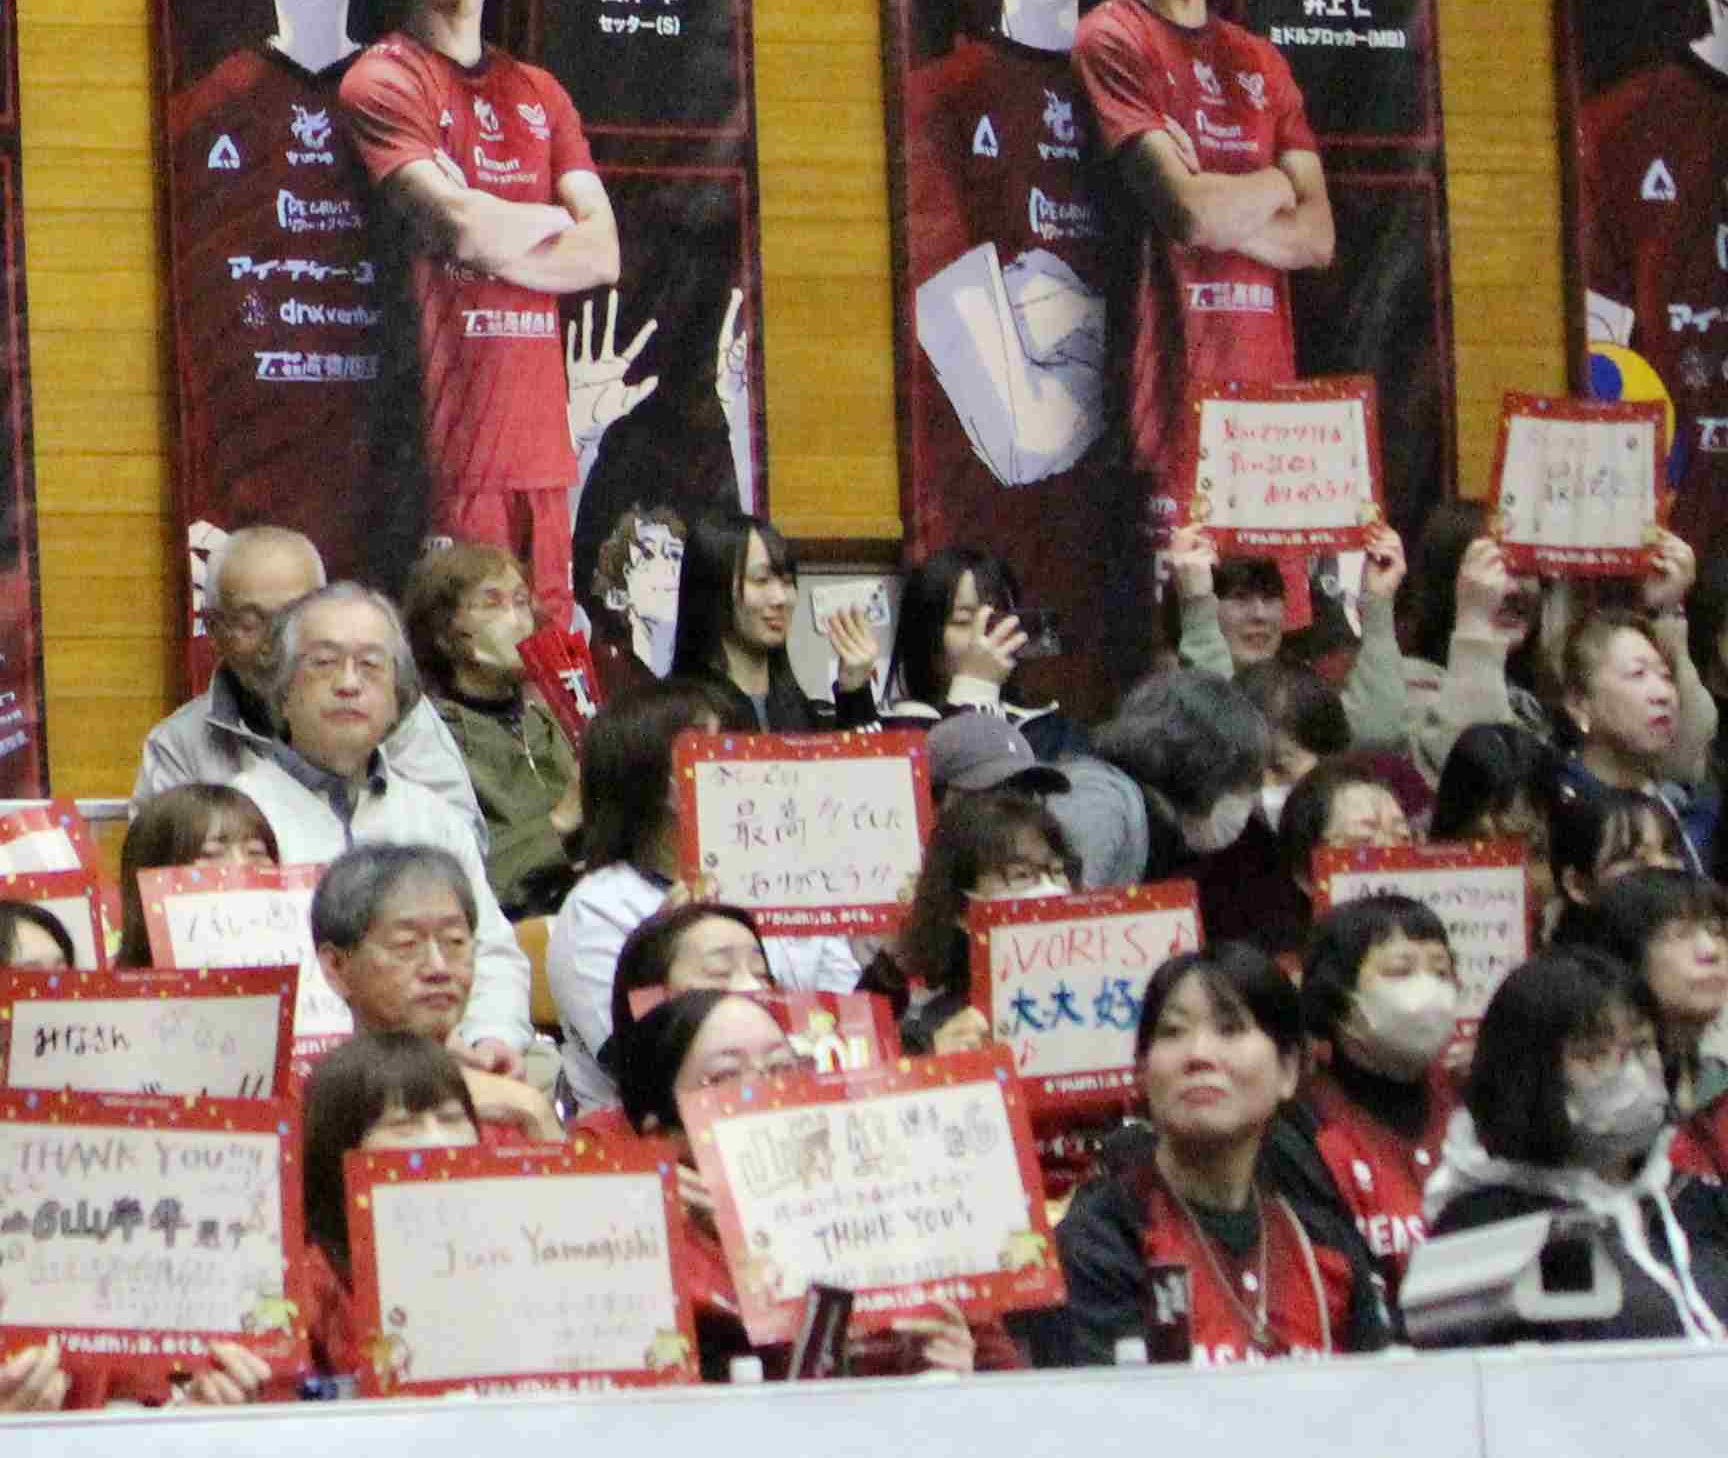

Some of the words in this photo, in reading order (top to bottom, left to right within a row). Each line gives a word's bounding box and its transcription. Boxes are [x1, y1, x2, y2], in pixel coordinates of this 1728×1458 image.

[598, 14, 681, 36] セッター(S)
[1270, 26, 1407, 49] ミドルブロッカー(MB)
